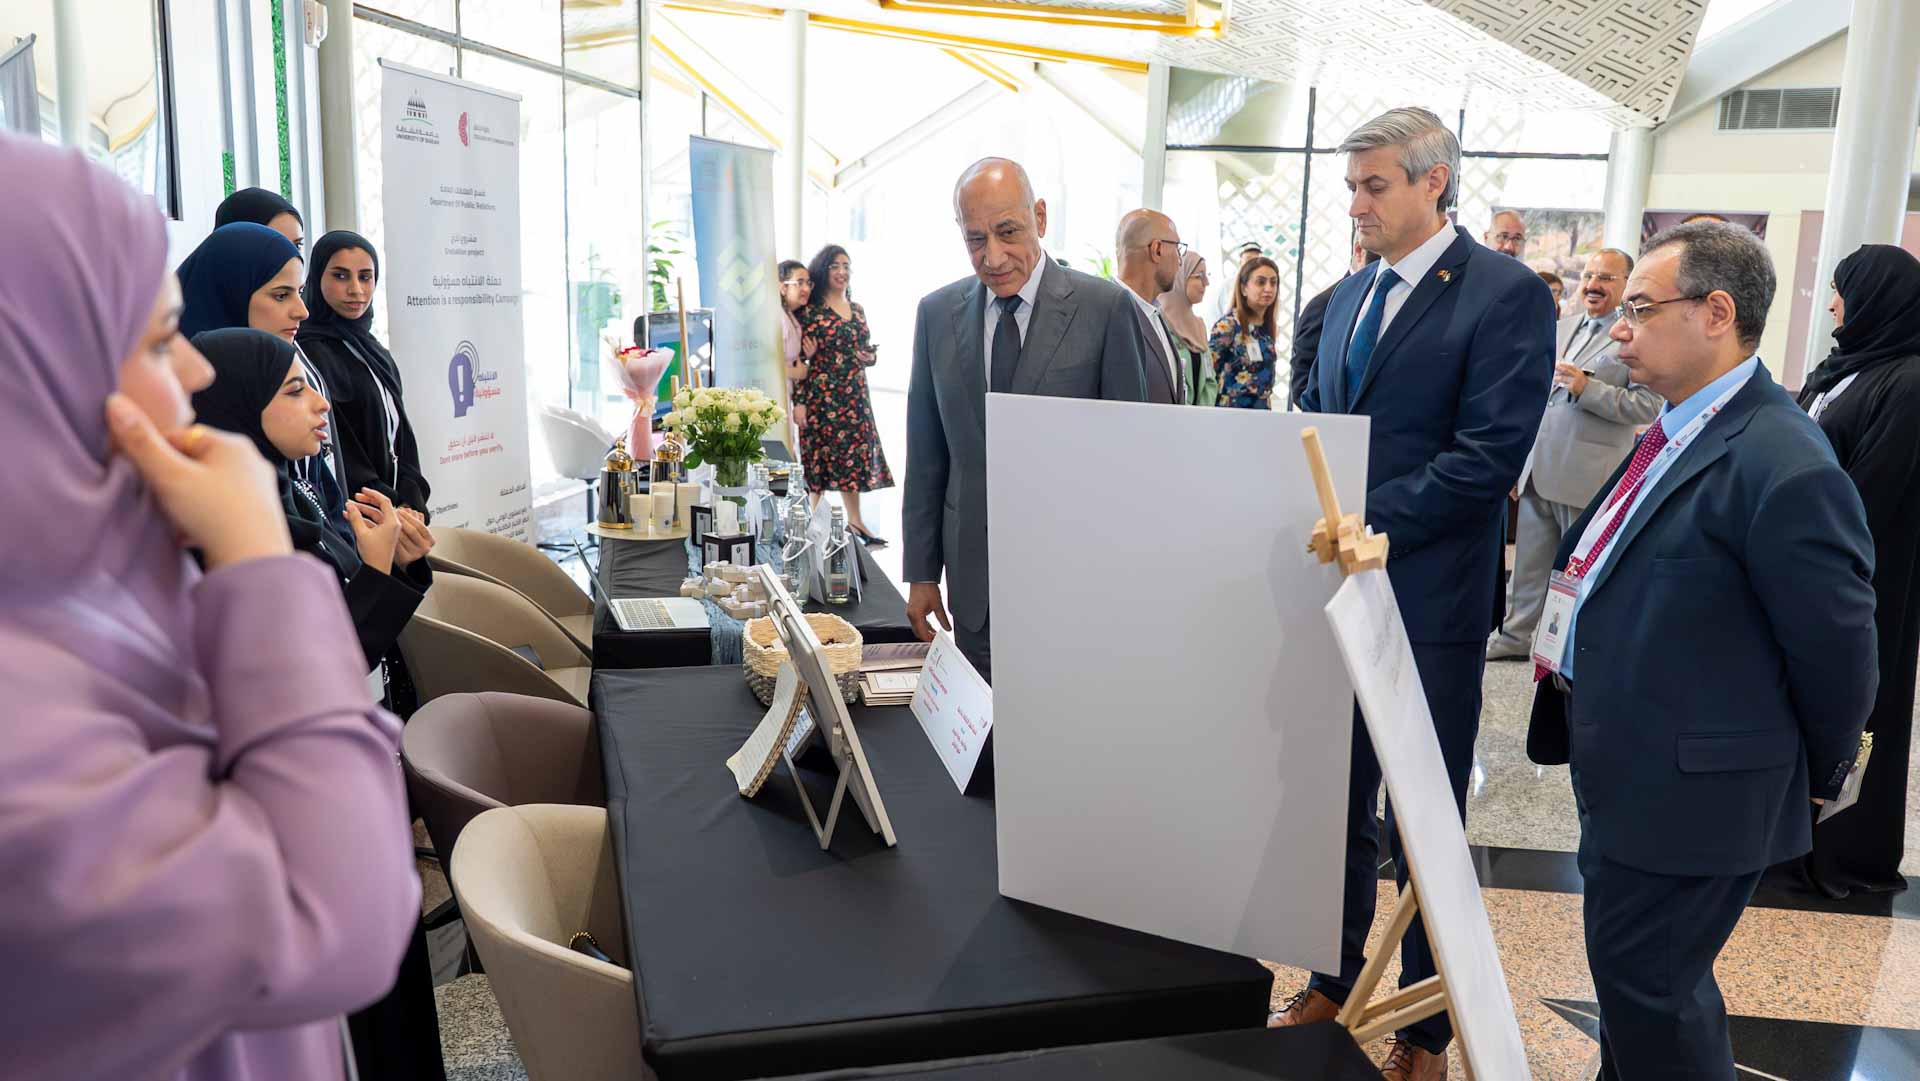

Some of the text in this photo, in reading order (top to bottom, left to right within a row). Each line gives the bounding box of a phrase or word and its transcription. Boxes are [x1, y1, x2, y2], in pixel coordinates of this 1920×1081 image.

[432, 274, 460, 290] مسؤولية
[407, 295, 440, 306] Attention
[441, 295, 447, 305] is
[453, 294, 494, 307] responsibility
